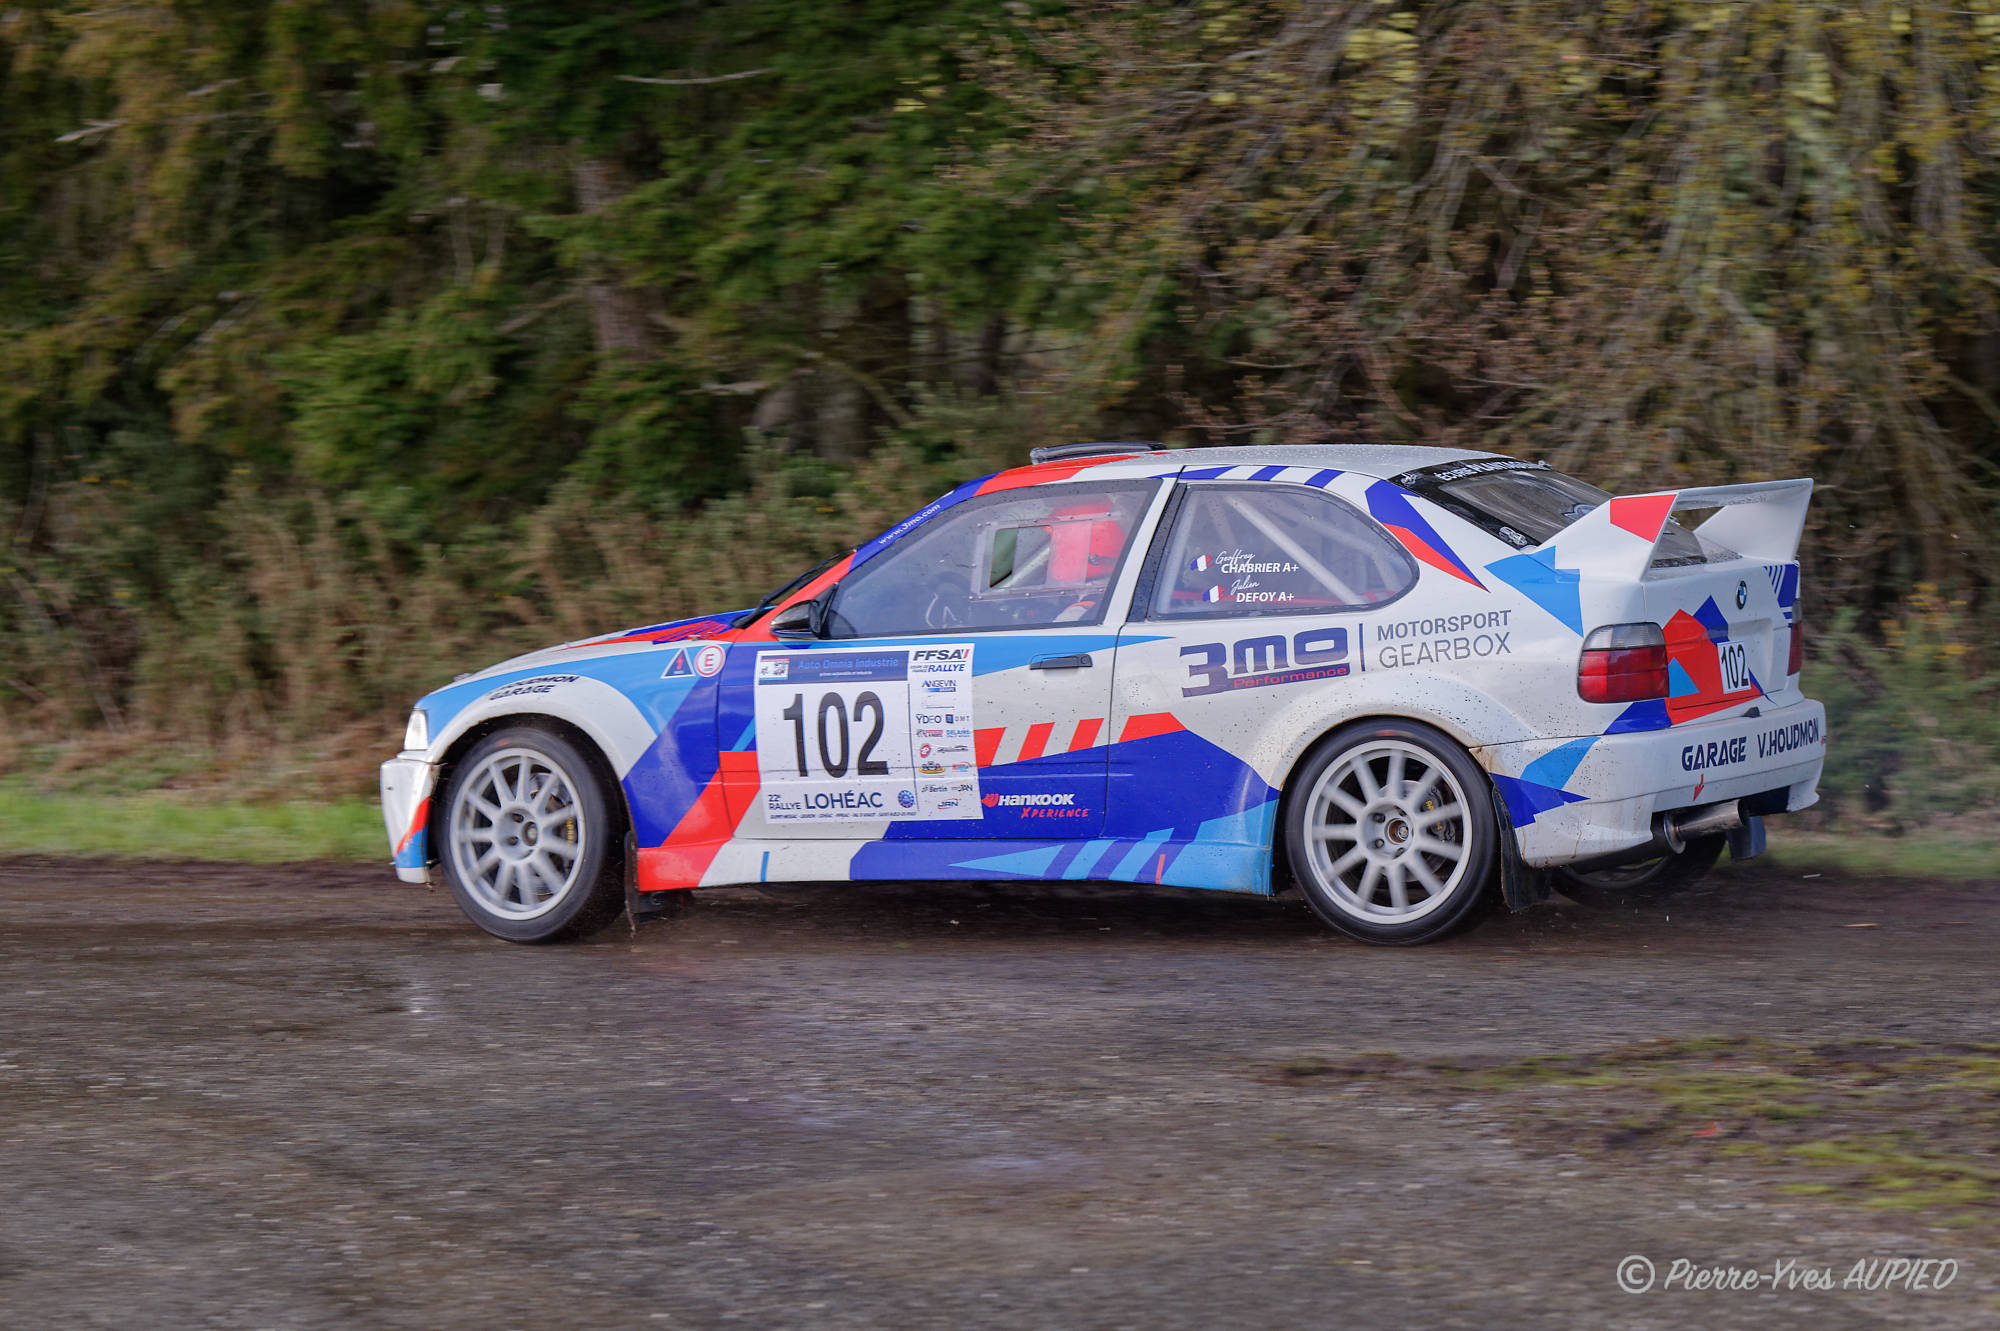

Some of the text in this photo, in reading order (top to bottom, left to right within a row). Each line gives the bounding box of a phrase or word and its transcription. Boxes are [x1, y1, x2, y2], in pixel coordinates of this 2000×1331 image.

[1221, 562, 1299, 574] CHABRIER A+
[1236, 591, 1295, 603] DEFOY A+
[1377, 609, 1512, 641] MOTORSPORT
[912, 649, 963, 661] FFSA
[1378, 631, 1512, 669] GEARBOX
[703, 652, 715, 667] E
[927, 663, 966, 673] RALLYE
[1721, 643, 1750, 690] 102
[1233, 666, 1348, 690] Performance
[782, 690, 890, 779] 102
[1681, 716, 1819, 772] GARAGE V.HOUDMON
[768, 802, 801, 810] RALLYE
[803, 790, 884, 810] LOHÉAC
[1020, 807, 1089, 819] XPERIENCE
